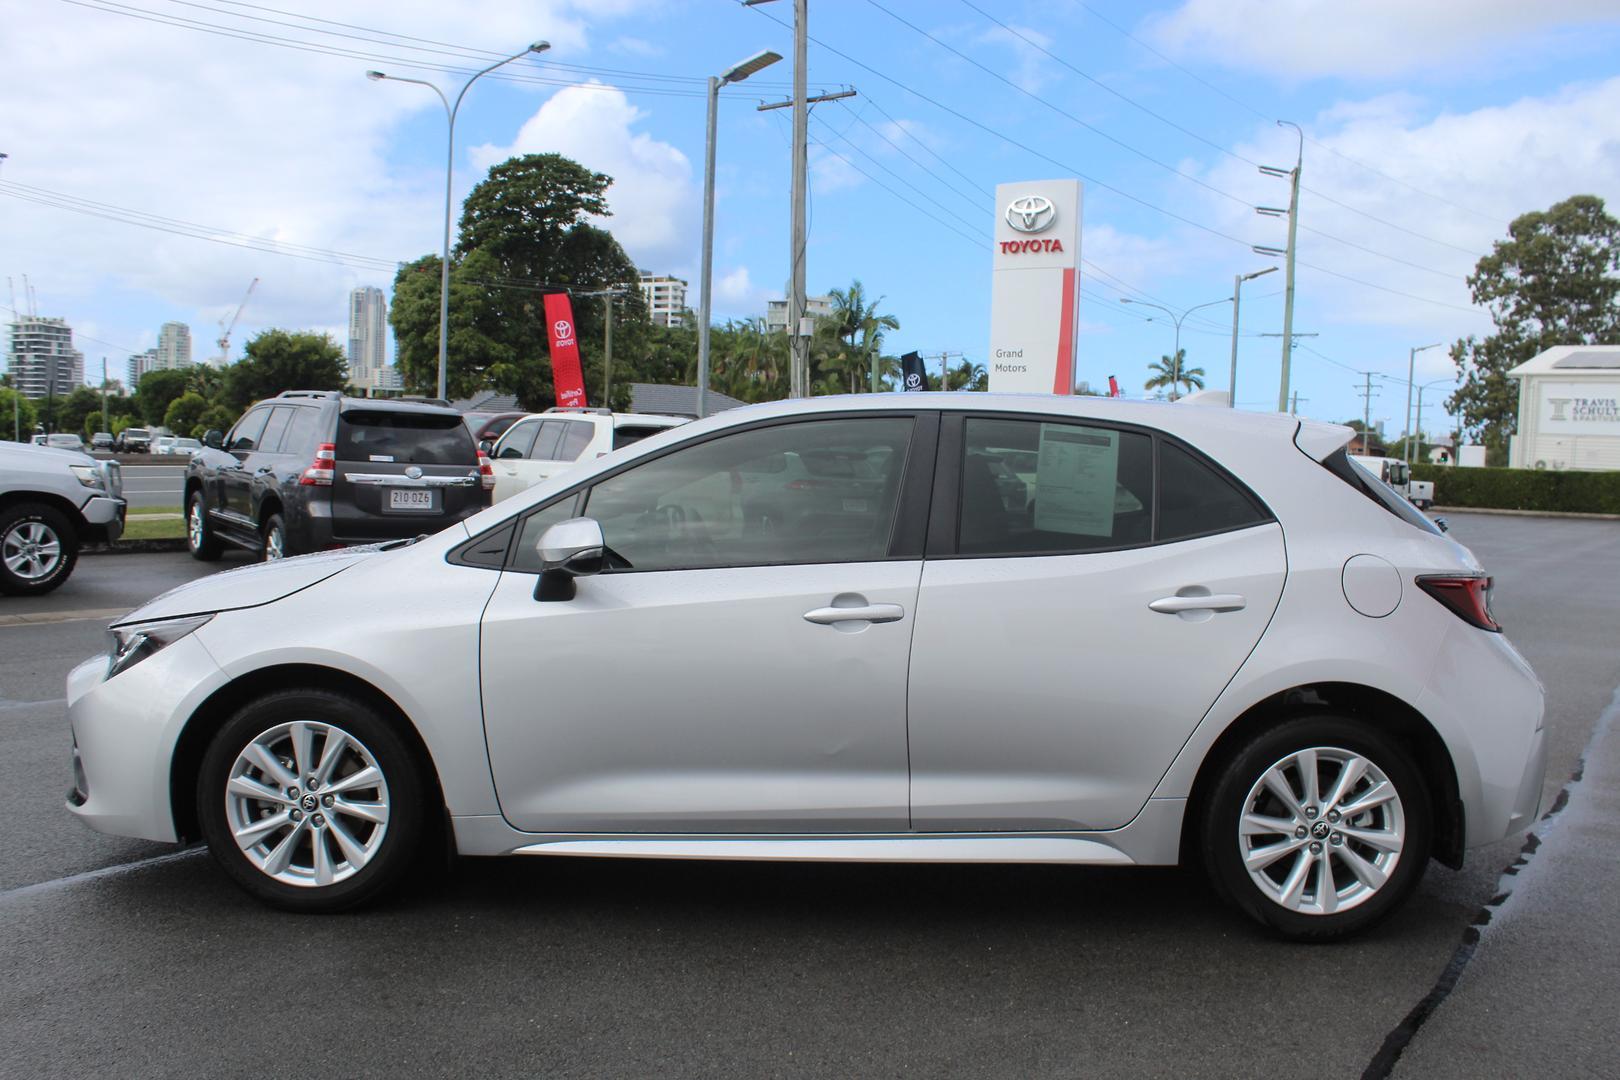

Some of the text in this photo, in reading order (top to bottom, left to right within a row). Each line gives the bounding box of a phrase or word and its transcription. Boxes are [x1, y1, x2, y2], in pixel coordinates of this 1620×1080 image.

[999, 239, 1064, 254] TOYOTA
[996, 348, 1023, 358] Grand
[995, 363, 1027, 373] Motors
[1573, 398, 1617, 407] TRAVIS
